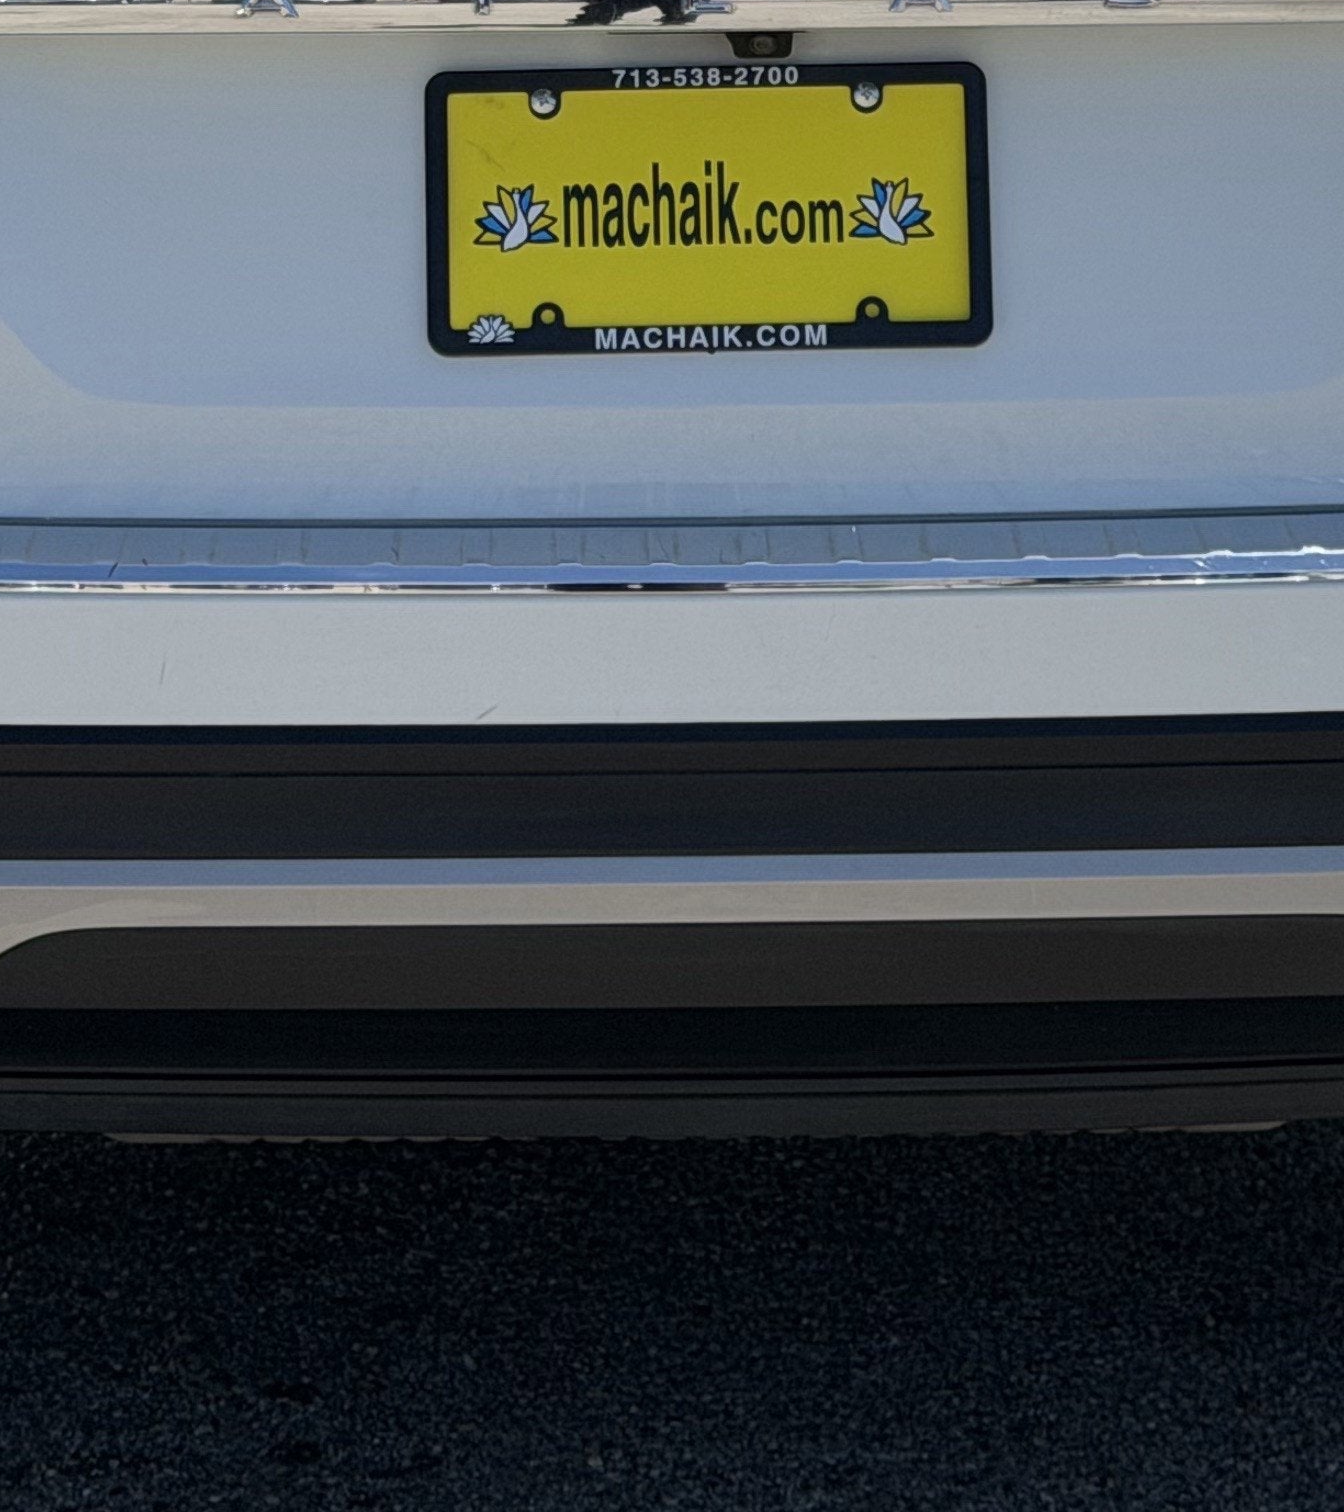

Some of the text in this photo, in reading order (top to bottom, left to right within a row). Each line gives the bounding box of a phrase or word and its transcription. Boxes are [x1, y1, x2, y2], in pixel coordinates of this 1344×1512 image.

[612, 66, 799, 88] 713-538-2700
[563, 160, 844, 248] machaik.com
[594, 324, 827, 350] MACHAIK.COM
